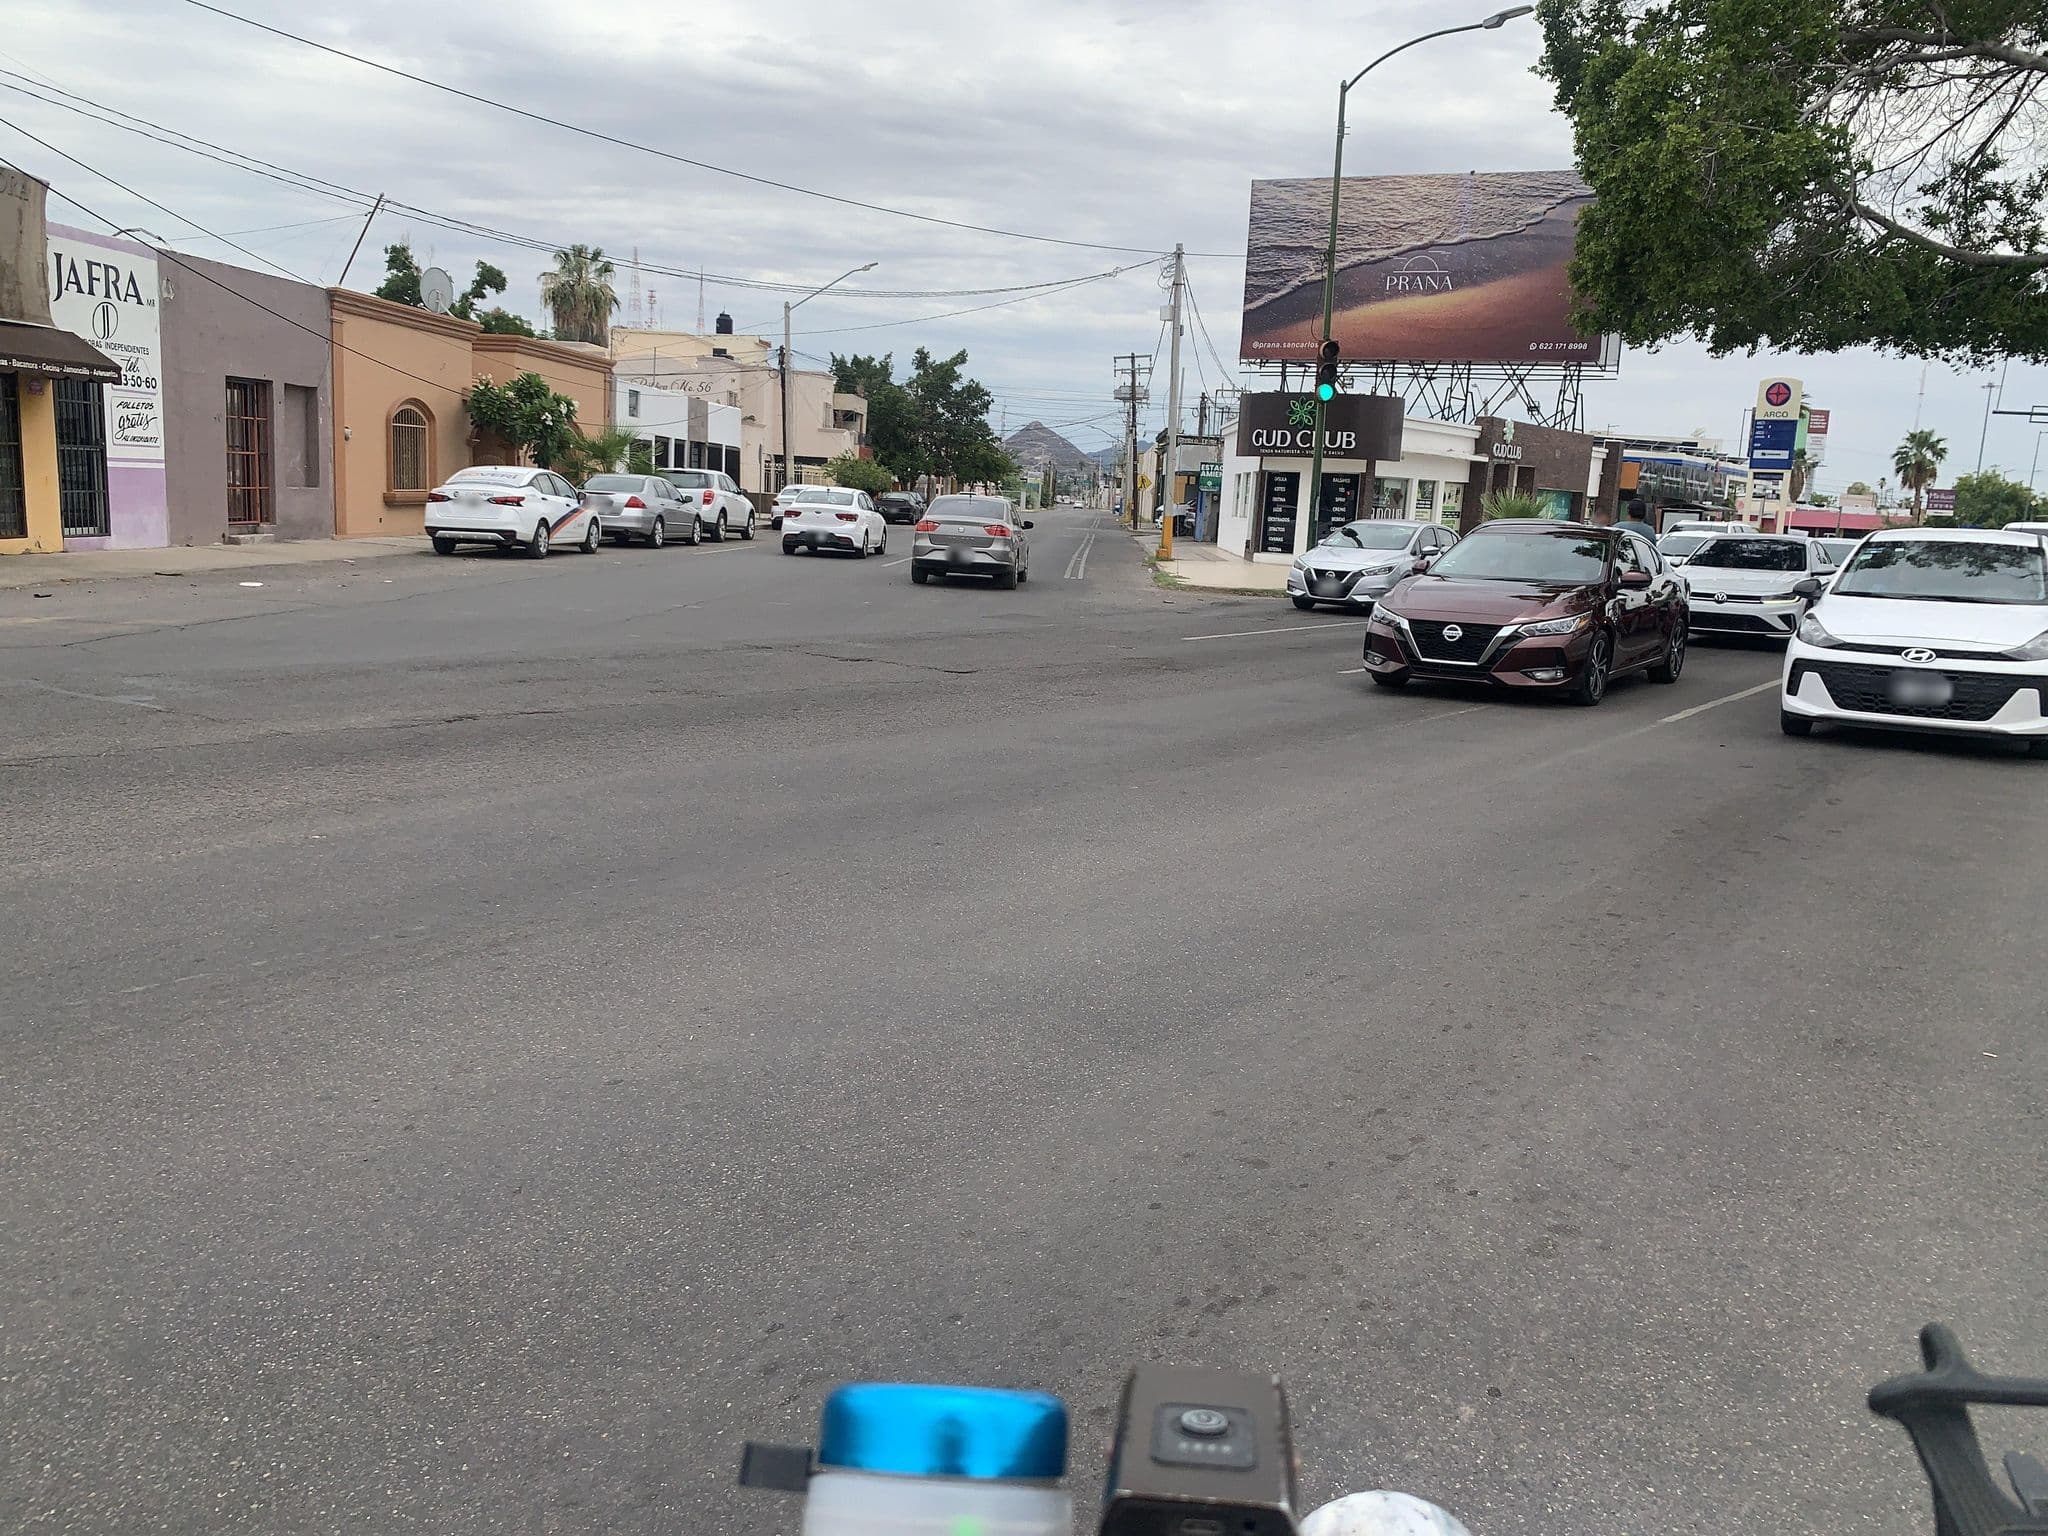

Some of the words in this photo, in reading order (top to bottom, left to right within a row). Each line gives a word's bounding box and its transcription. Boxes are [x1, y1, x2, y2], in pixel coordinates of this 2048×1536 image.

[53, 251, 145, 306] JAFRA
[1386, 275, 1453, 291] PRANA
[104, 340, 150, 356] INDEPENDIENTES
[1252, 340, 1319, 349] @prana.sancarlos
[1538, 342, 1554, 350] 622
[1555, 342, 1567, 350] 171
[1568, 342, 1588, 350] 8998
[696, 381, 714, 393] 56
[116, 400, 155, 410] FOLLETOS
[114, 412, 158, 440] gratis
[1252, 428, 1292, 448] GUD
[1295, 429, 1357, 449] CLUB
